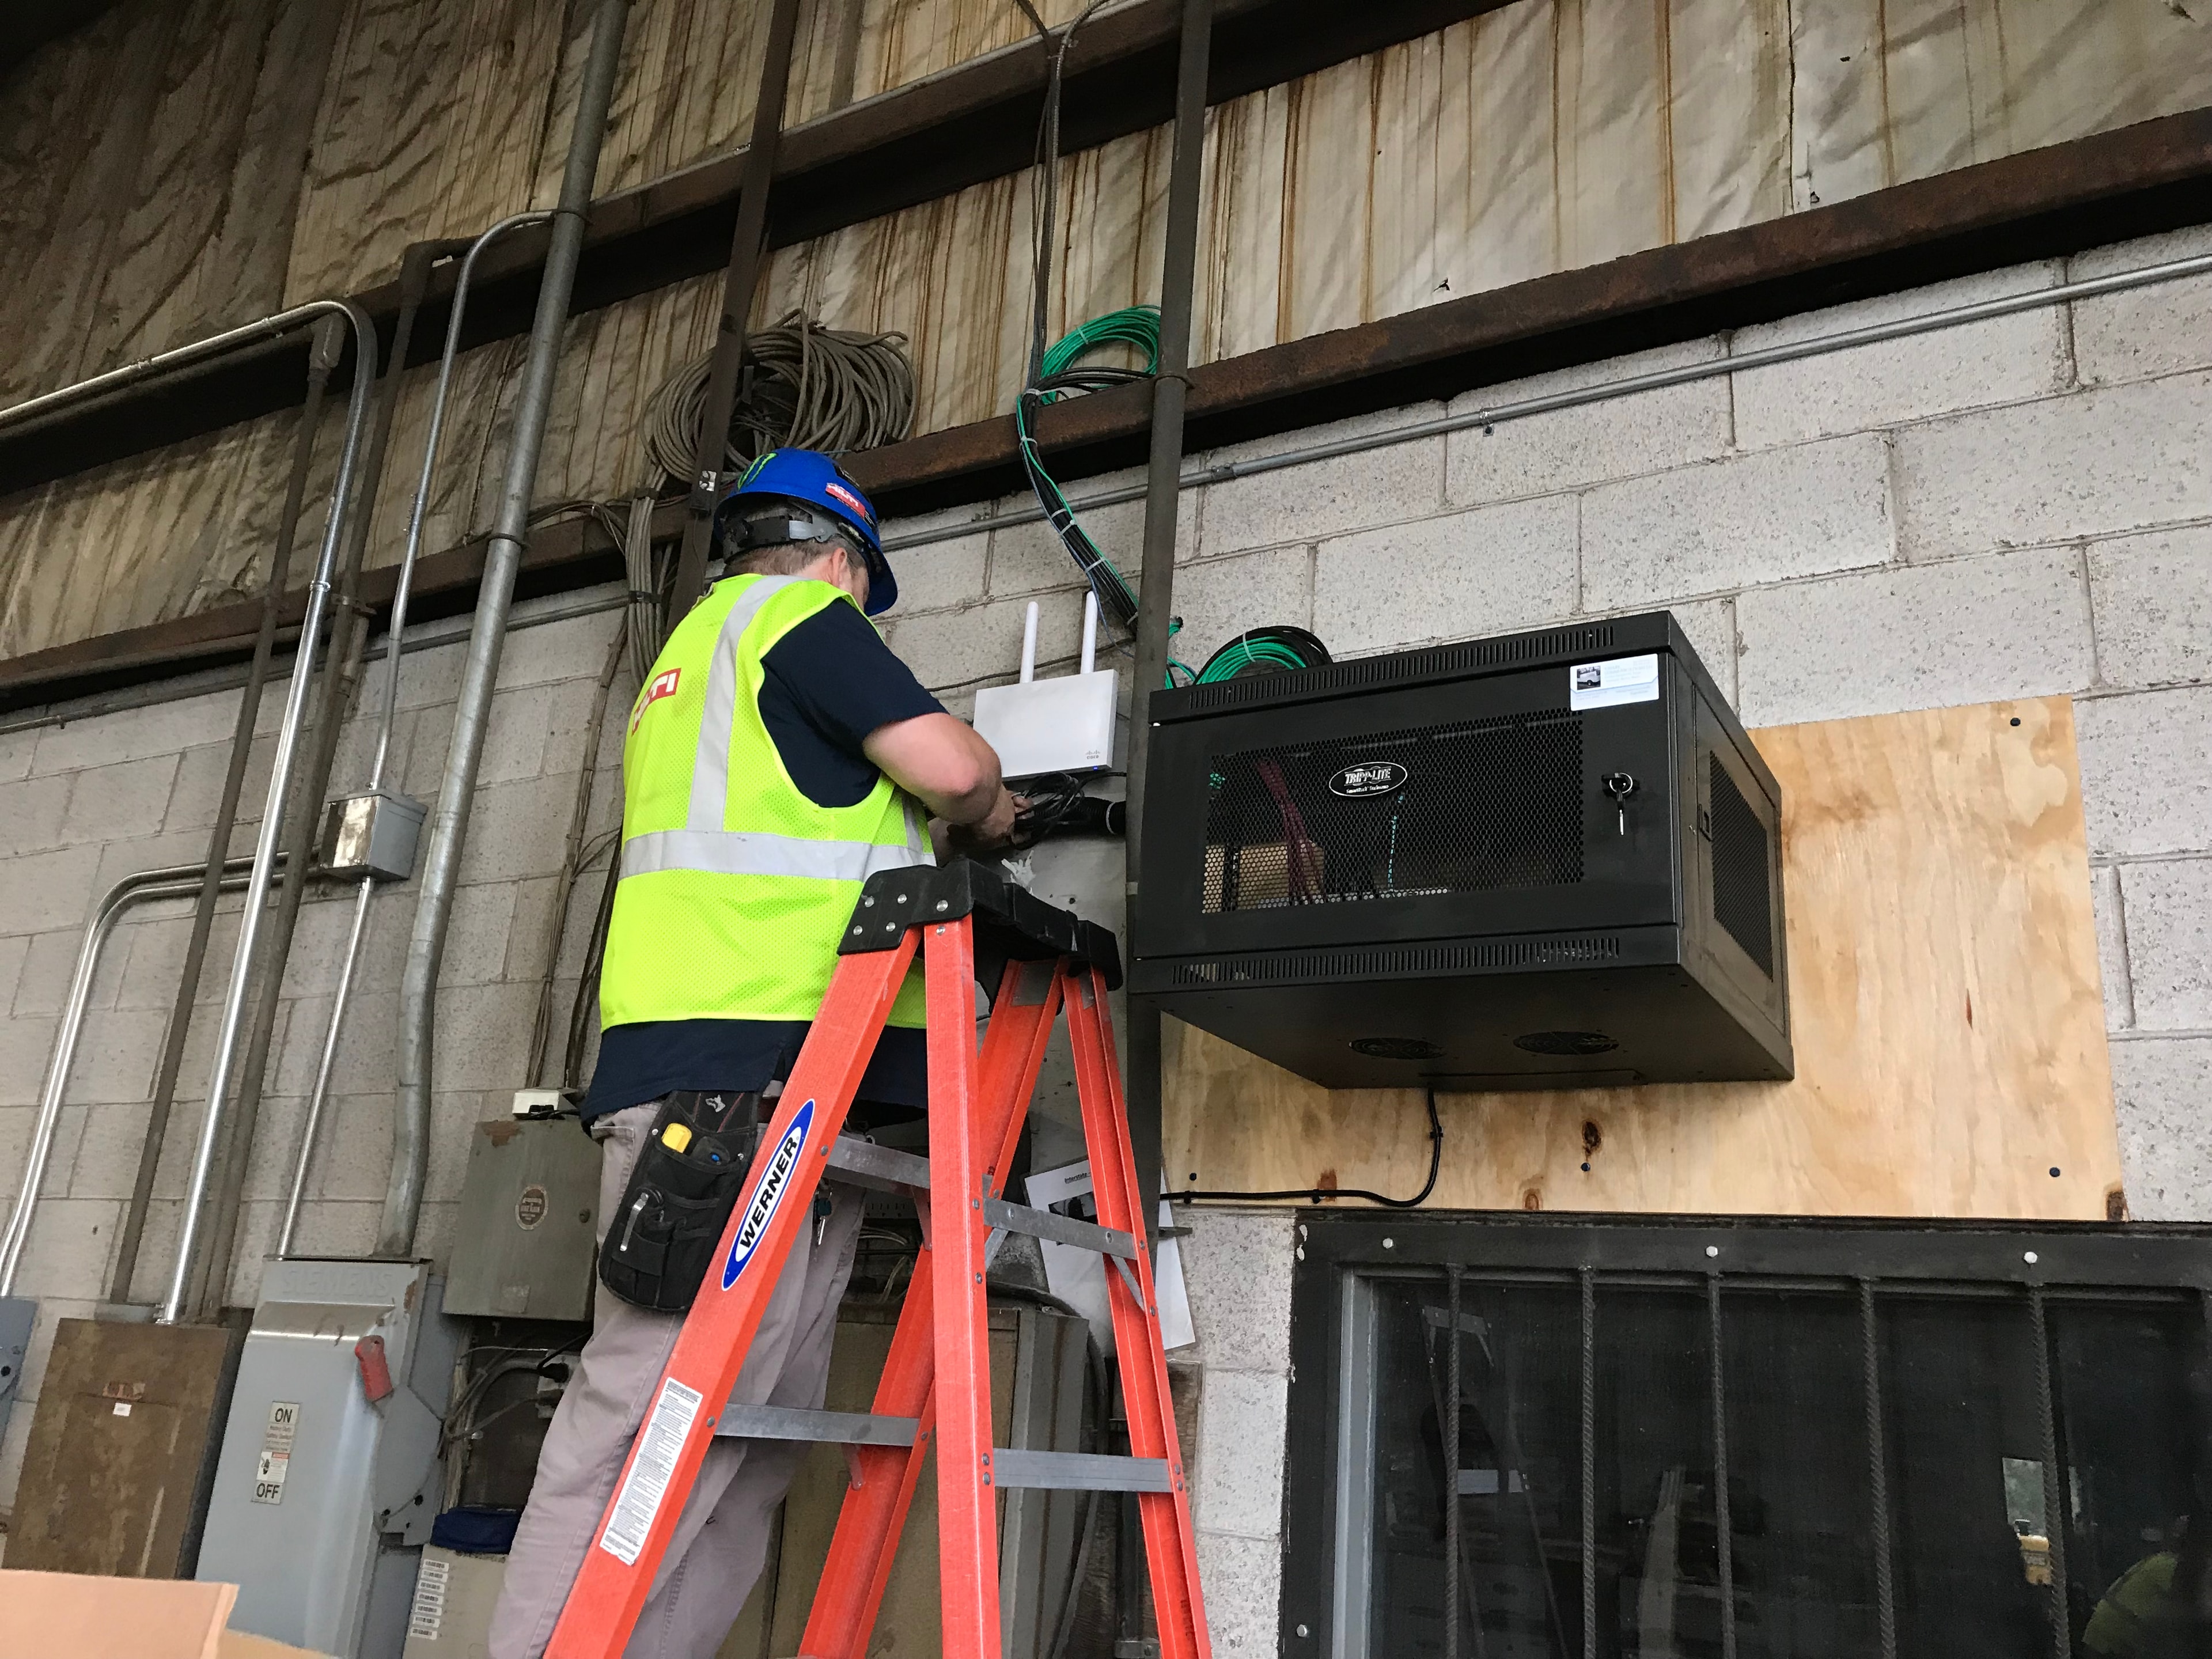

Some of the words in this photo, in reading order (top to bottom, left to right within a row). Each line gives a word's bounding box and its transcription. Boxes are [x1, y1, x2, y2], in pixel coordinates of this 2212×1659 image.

[740, 1137, 798, 1248] WERNER
[282, 1268, 393, 1297] SIEMENS
[274, 1407, 293, 1423] ON
[256, 1482, 281, 1499] OFF
